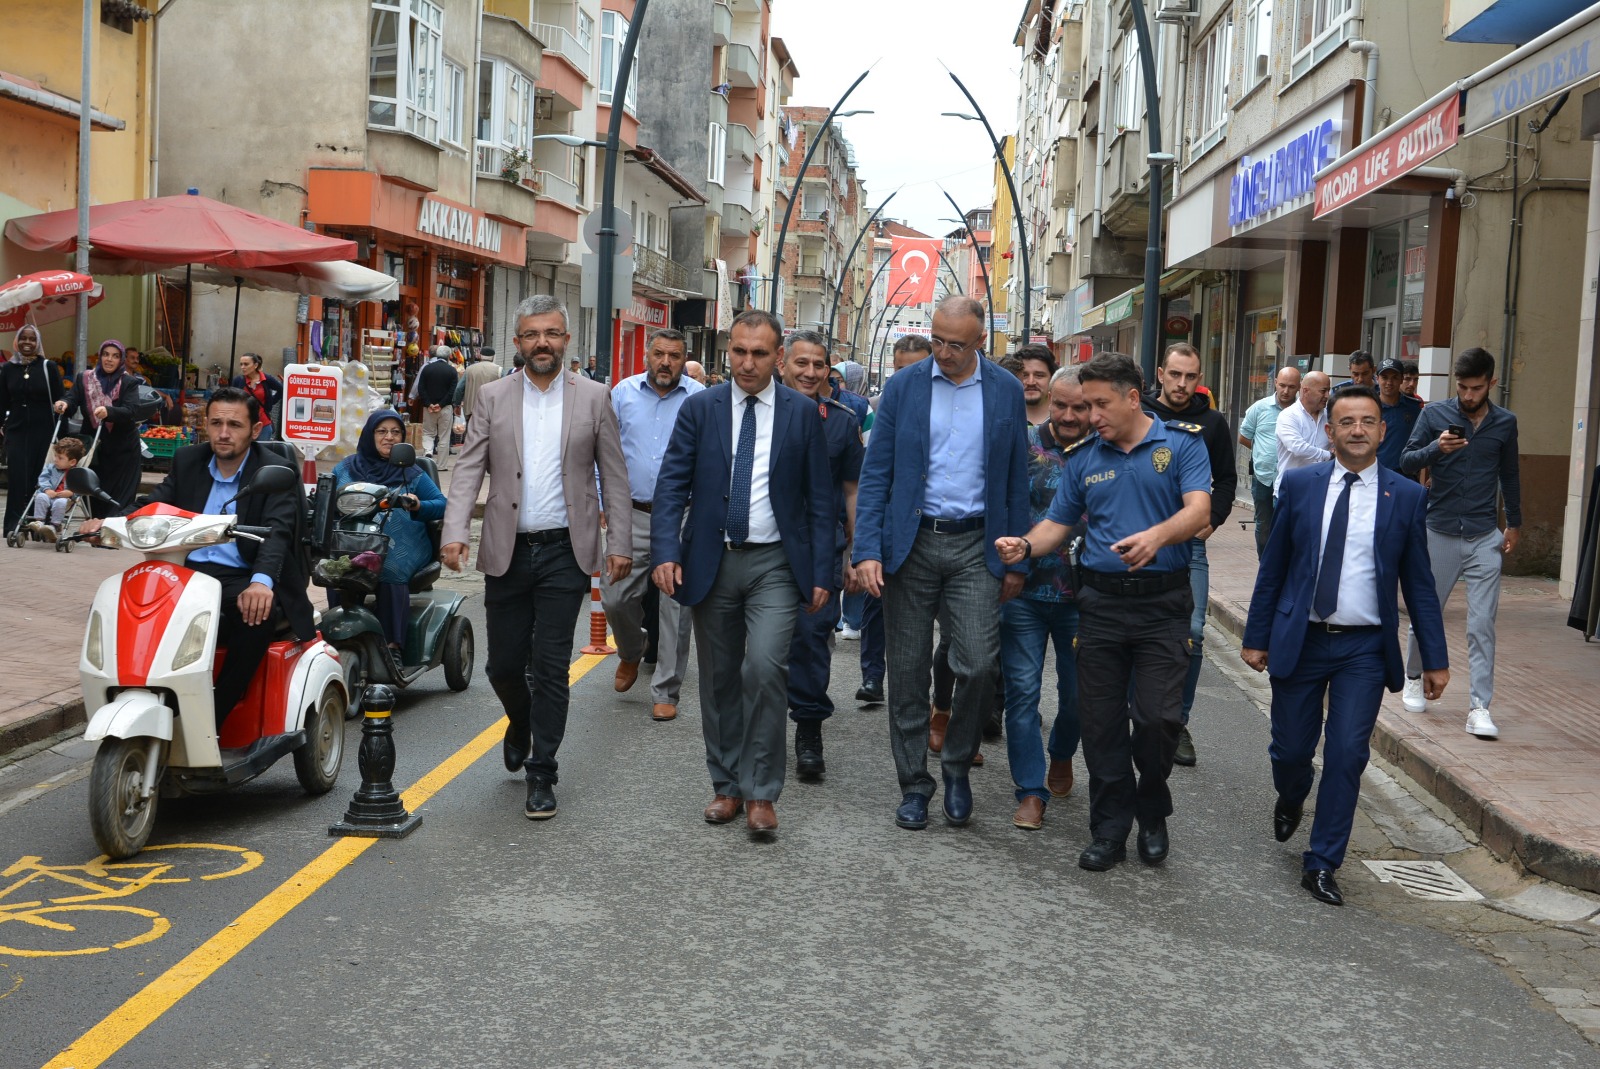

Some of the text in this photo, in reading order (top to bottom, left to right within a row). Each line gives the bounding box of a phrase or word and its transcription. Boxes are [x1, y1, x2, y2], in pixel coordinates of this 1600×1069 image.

[1491, 39, 1591, 118] YÖNDEM
[1321, 112, 1444, 209] MODA LİFE BUTİK
[417, 196, 502, 253] AKKAYA AVM
[322, 379, 336, 389] EŞYA
[289, 424, 332, 433] HOŞGELDİNİZ
[127, 565, 179, 582] SALCANO
